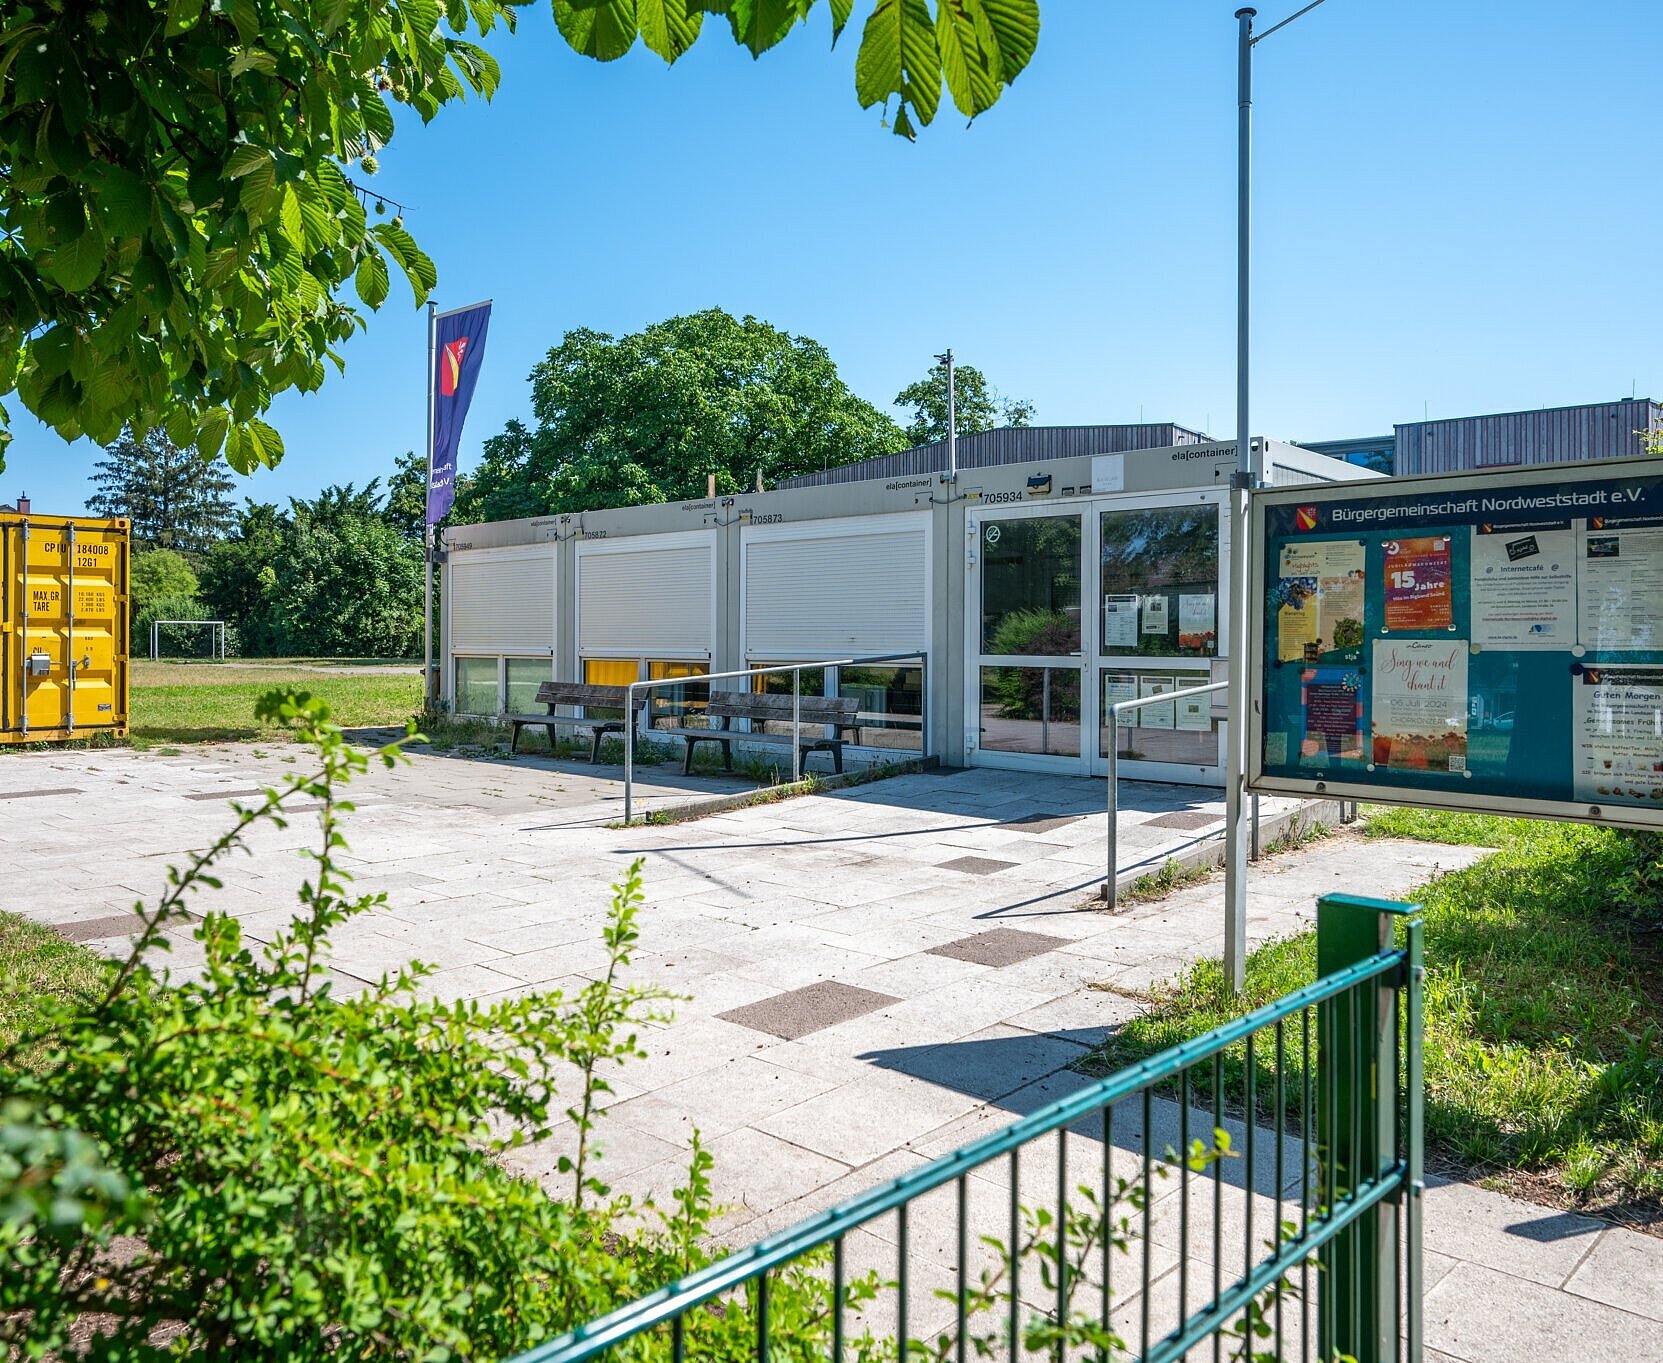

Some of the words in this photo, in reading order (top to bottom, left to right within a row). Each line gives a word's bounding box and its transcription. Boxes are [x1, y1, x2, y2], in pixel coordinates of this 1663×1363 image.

[1171, 445, 1238, 461] ela[container]
[886, 477, 932, 491] ela[container]
[983, 491, 1023, 504] 705934
[1332, 499, 1479, 523] Bürgergemeinschaft
[1481, 490, 1607, 512] Nordweststadt
[1610, 487, 1646, 503] e.V.
[753, 513, 783, 525] 705873
[584, 530, 607, 540] 705872
[44, 542, 67, 553] CPIU
[77, 544, 109, 555] 184008
[77, 557, 97, 567] 12G1
[1500, 563, 1544, 573] Internetcafé
[1390, 570, 1416, 589] 15
[1414, 580, 1446, 591] Jahre
[33, 601, 50, 612] TARE
[1377, 647, 1413, 682] Sing
[1416, 659, 1430, 668] we
[1432, 648, 1459, 670] and
[1407, 670, 1435, 691] chant
[1436, 674, 1447, 691] it
[1593, 690, 1621, 699] Guten
[1624, 691, 1661, 701] Morgen
[1405, 699, 1421, 708] Juli
[1423, 700, 1448, 709] 2024
